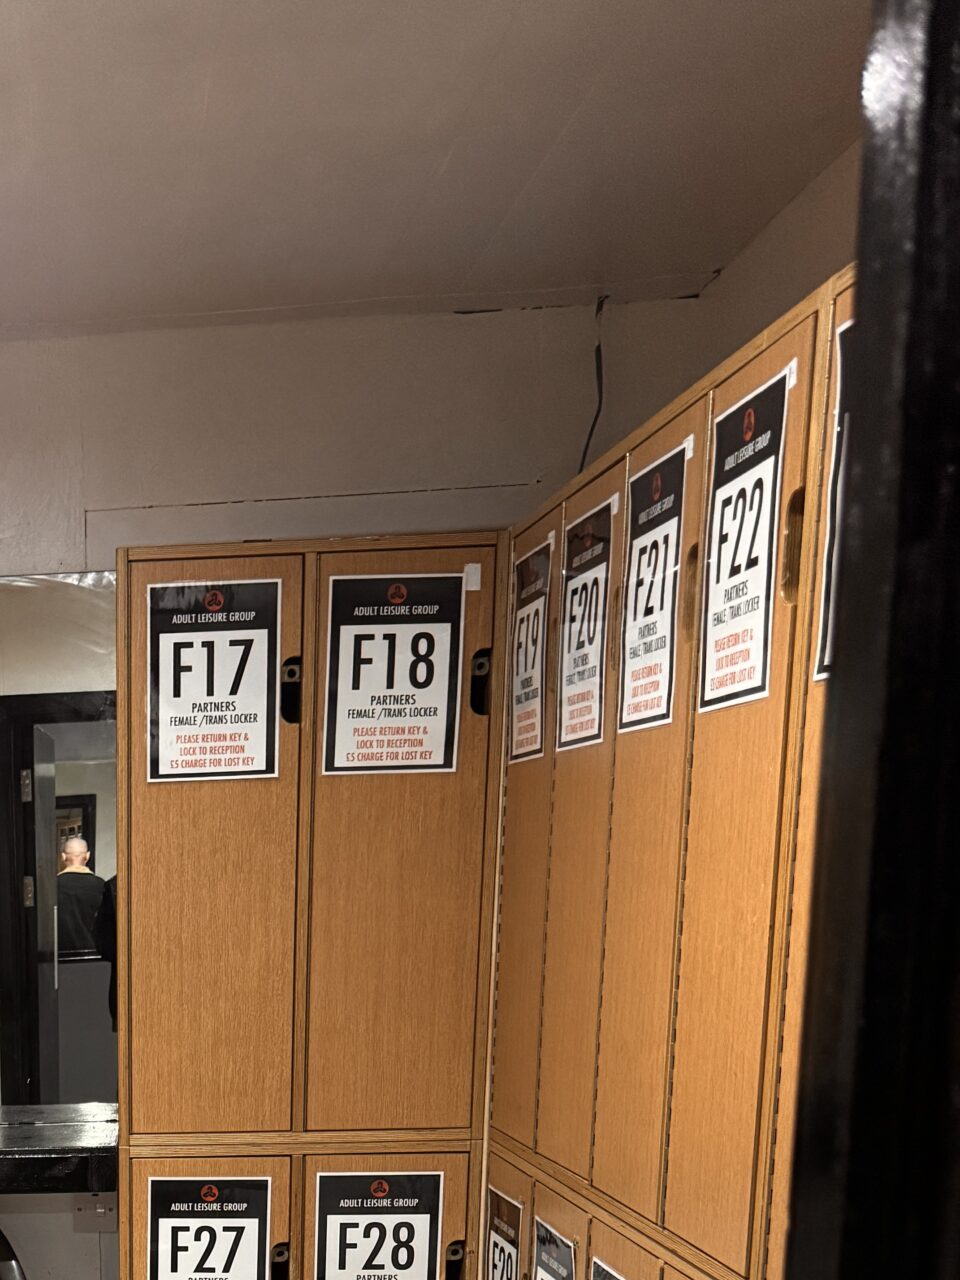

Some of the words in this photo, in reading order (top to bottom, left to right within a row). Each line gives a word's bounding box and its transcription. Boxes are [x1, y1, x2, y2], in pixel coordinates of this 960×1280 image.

[715, 477, 764, 585] F22
[633, 534, 668, 621] F21
[723, 579, 749, 605] PARTNERS
[353, 606, 378, 616] ADULT
[379, 605, 410, 616] LEISURE
[411, 604, 440, 615] GROUP
[171, 613, 196, 624] ADULT
[197, 612, 228, 623] LEISURE
[229, 611, 256, 622] GROUP
[568, 581, 599, 654] F20
[516, 608, 540, 677] F19
[351, 631, 436, 691] F18
[172, 638, 255, 699] F17
[370, 693, 417, 706] PARTNERS
[191, 700, 237, 714] PARTNERS
[347, 708, 376, 720] FEMALE
[376, 707, 408, 721] /TRANS
[409, 706, 439, 718] LOCKER
[169, 715, 198, 727] FEMALE
[198, 714, 229, 728] /TRANS
[229, 712, 258, 725] LOCKER
[175, 733, 200, 744] PLEASE
[201, 733, 228, 743] RETURN
[229, 732, 242, 742] KEY
[243, 732, 249, 742] &
[352, 726, 378, 737] PLEASE
[378, 726, 406, 736] RETURN
[407, 725, 422, 736] KEY
[422, 726, 429, 736] &
[179, 746, 197, 757] LOCK
[198, 746, 208, 756] TO
[209, 744, 245, 755] RECEPTION
[356, 739, 374, 750] LOCK
[375, 739, 385, 749] TO
[386, 738, 424, 749] RECEPTION
[170, 759, 180, 769] £5
[180, 758, 207, 769] CHARGE
[208, 758, 223, 768] FOR
[223, 756, 241, 767] LOST
[241, 756, 255, 766] KEY
[346, 752, 356, 762] £5
[356, 751, 384, 762] CHARGE
[385, 751, 400, 761] FOR
[400, 750, 418, 761] LOST
[419, 750, 433, 760] KEY
[170, 1202, 193, 1211] ADULT
[194, 1202, 222, 1212] LEISURE
[223, 1202, 248, 1212] GROUP
[339, 1198, 362, 1208] ADULT
[363, 1198, 392, 1208] LEISURE
[393, 1198, 419, 1207] GROUP
[170, 1225, 246, 1274] F27
[338, 1221, 416, 1271] F28
